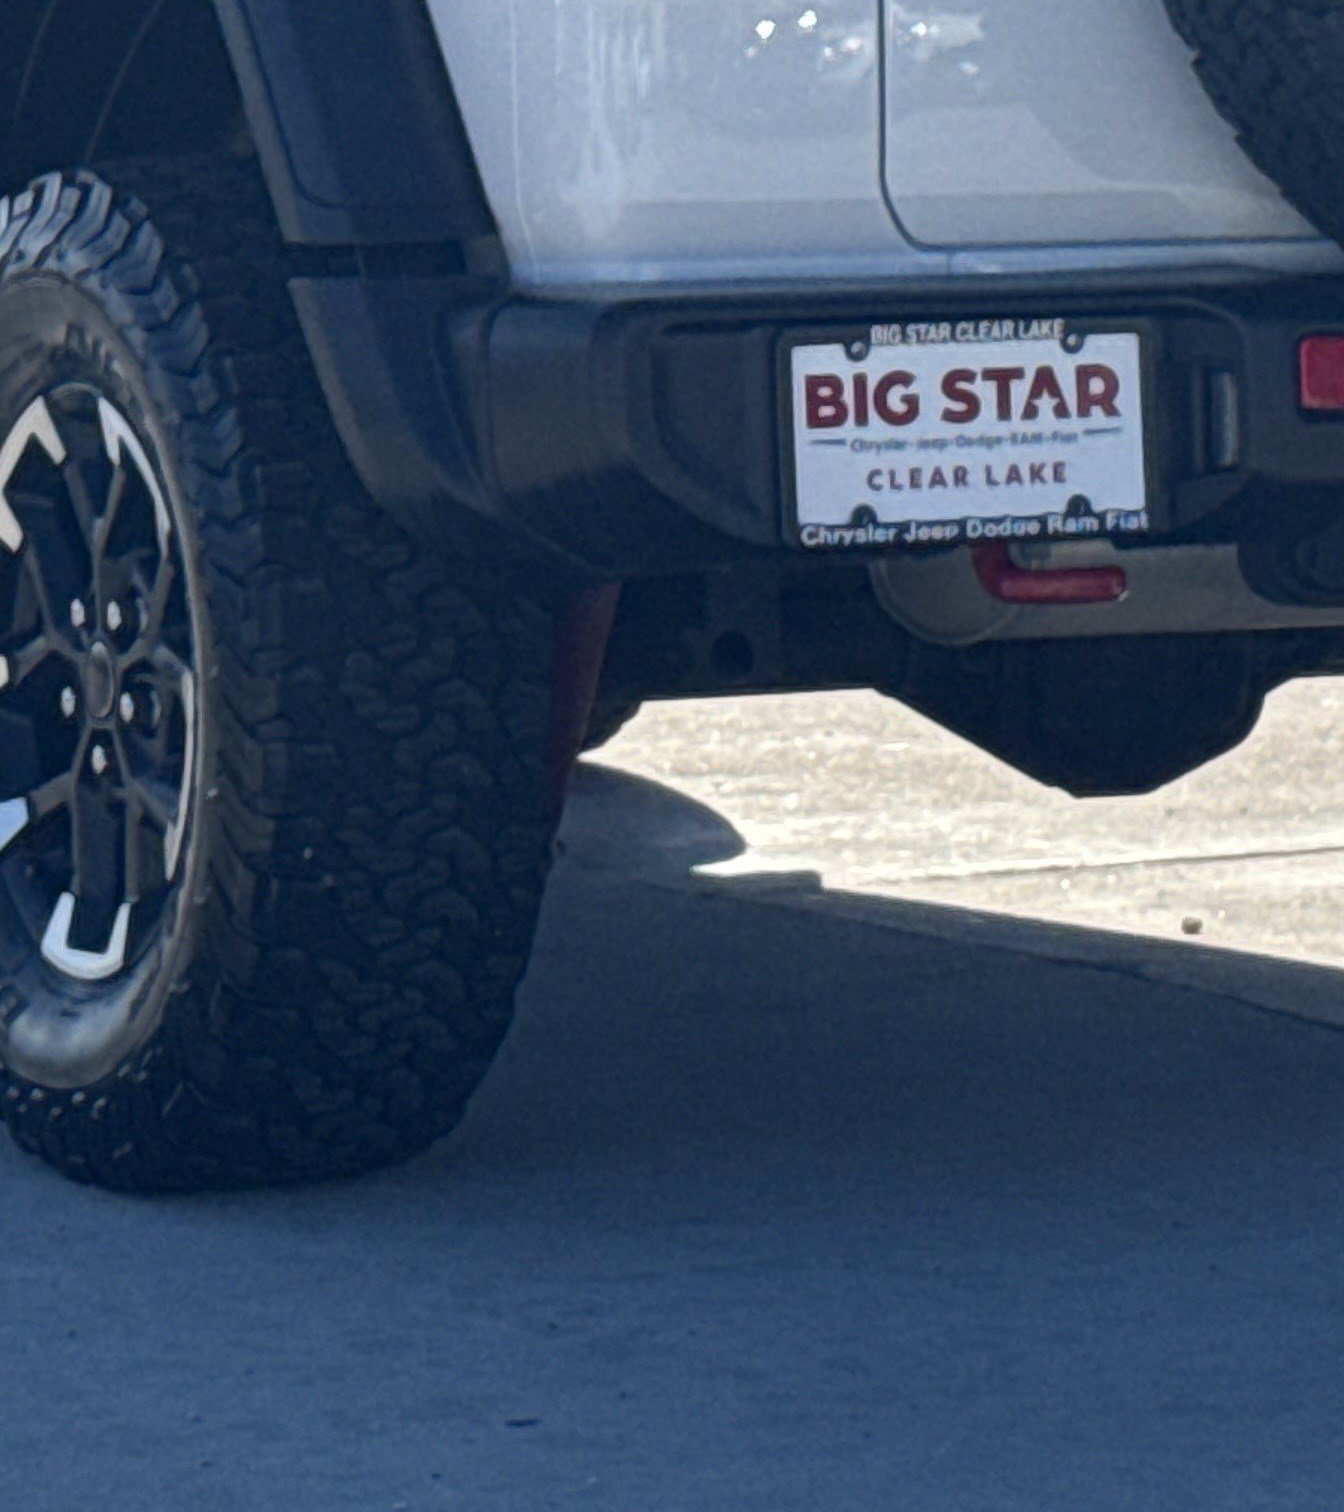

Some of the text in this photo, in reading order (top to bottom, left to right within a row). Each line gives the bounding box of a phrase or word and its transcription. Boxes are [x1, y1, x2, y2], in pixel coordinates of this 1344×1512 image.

[869, 317, 1066, 345] BIG STAR CLEAR LAKE
[804, 363, 1122, 430] BIG STAR
[866, 460, 1068, 492] CLEAR LAKE
[799, 521, 897, 549] Chrysler
[903, 519, 960, 545] Jeep
[965, 515, 1042, 539] Dodge
[1047, 510, 1100, 536] Ram
